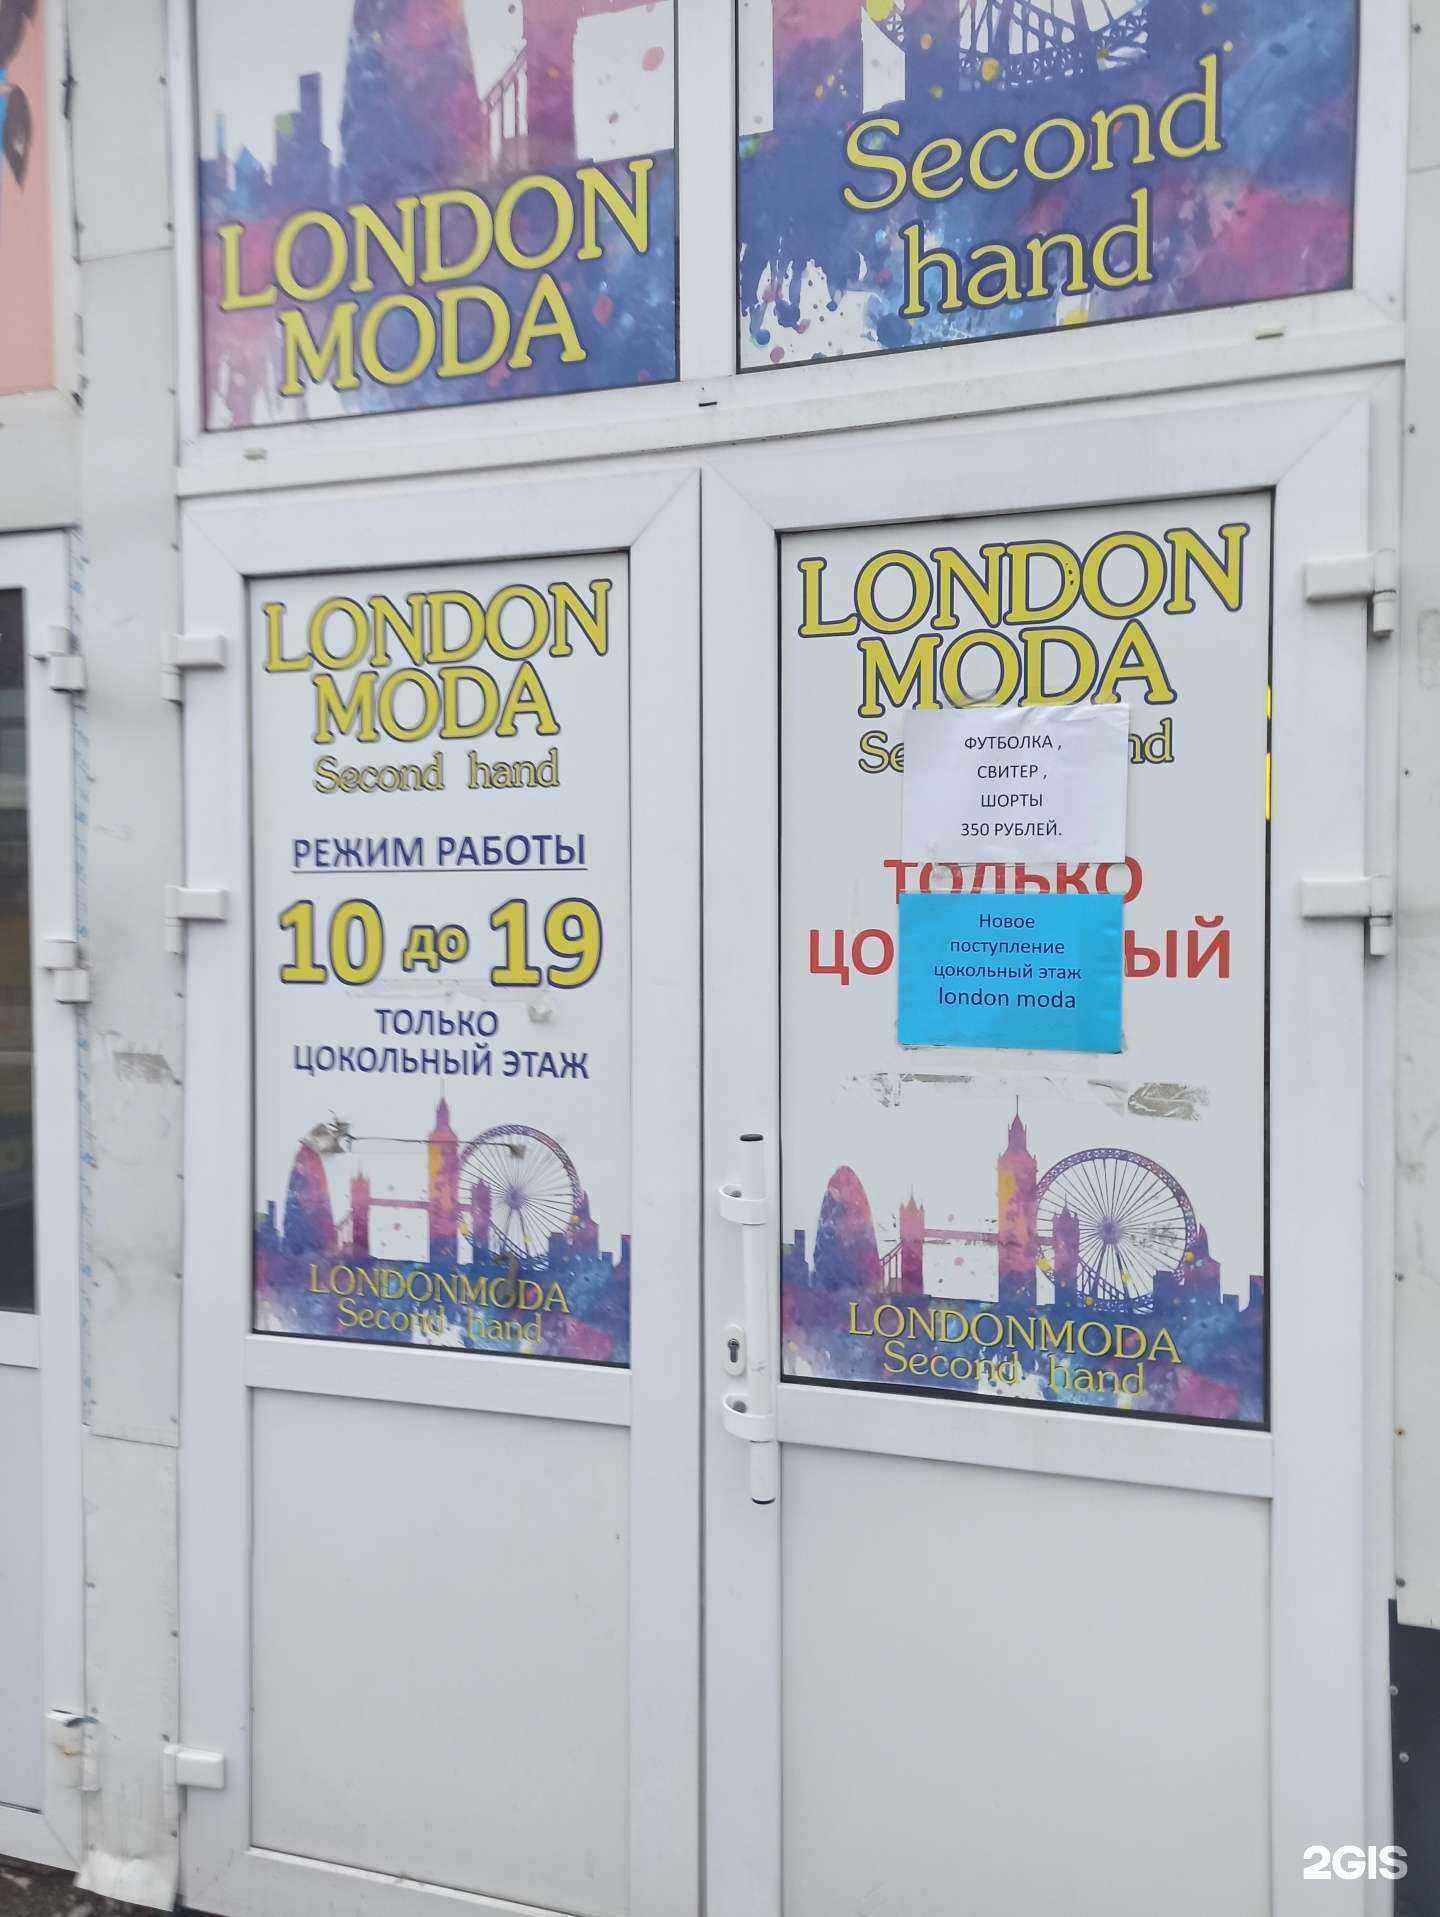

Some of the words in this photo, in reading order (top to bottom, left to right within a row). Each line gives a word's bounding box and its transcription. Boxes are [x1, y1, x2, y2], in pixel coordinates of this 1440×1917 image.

[842, 51, 1223, 212] Second
[215, 157, 655, 314] LONDON
[901, 187, 1154, 317] hand
[278, 271, 588, 398] MODA
[798, 522, 1251, 639] LONDON
[263, 578, 613, 674] LONDON
[857, 618, 1178, 720] MODA
[311, 660, 561, 744] MODA
[964, 734, 1053, 751] ФУТБОЛКА
[312, 750, 446, 795] Second
[466, 747, 561, 791] hand
[977, 764, 1039, 780] СВИТЕР
[981, 793, 1043, 808] ШОРТЫ
[293, 836, 424, 868] РЕЖИМ
[437, 833, 586, 867] РАБОТЫ
[961, 822, 990, 837] 350
[994, 819, 1062, 837] РУБЛЕЙ.
[279, 898, 384, 986] 10
[401, 924, 470, 973] до
[489, 897, 603, 989] 19
[979, 913, 1036, 929] Новое
[950, 938, 1065, 956] поступление
[933, 963, 1033, 980] цокольный
[1038, 968, 1082, 981] этаж
[938, 987, 1010, 1007] london
[1016, 990, 1077, 1009] moda
[374, 1008, 499, 1037] ТОЛЬКО
[293, 1042, 493, 1077] ЦОКОЛЬНЫЙ
[501, 1051, 590, 1079] ЭТАЖ
[307, 1263, 571, 1314] LONDONMODA
[336, 1298, 446, 1335] Second
[467, 1307, 543, 1345] hand
[848, 1301, 1181, 1364] LONDONMODA
[882, 1339, 1020, 1386] Second
[1048, 1352, 1145, 1397] hand
